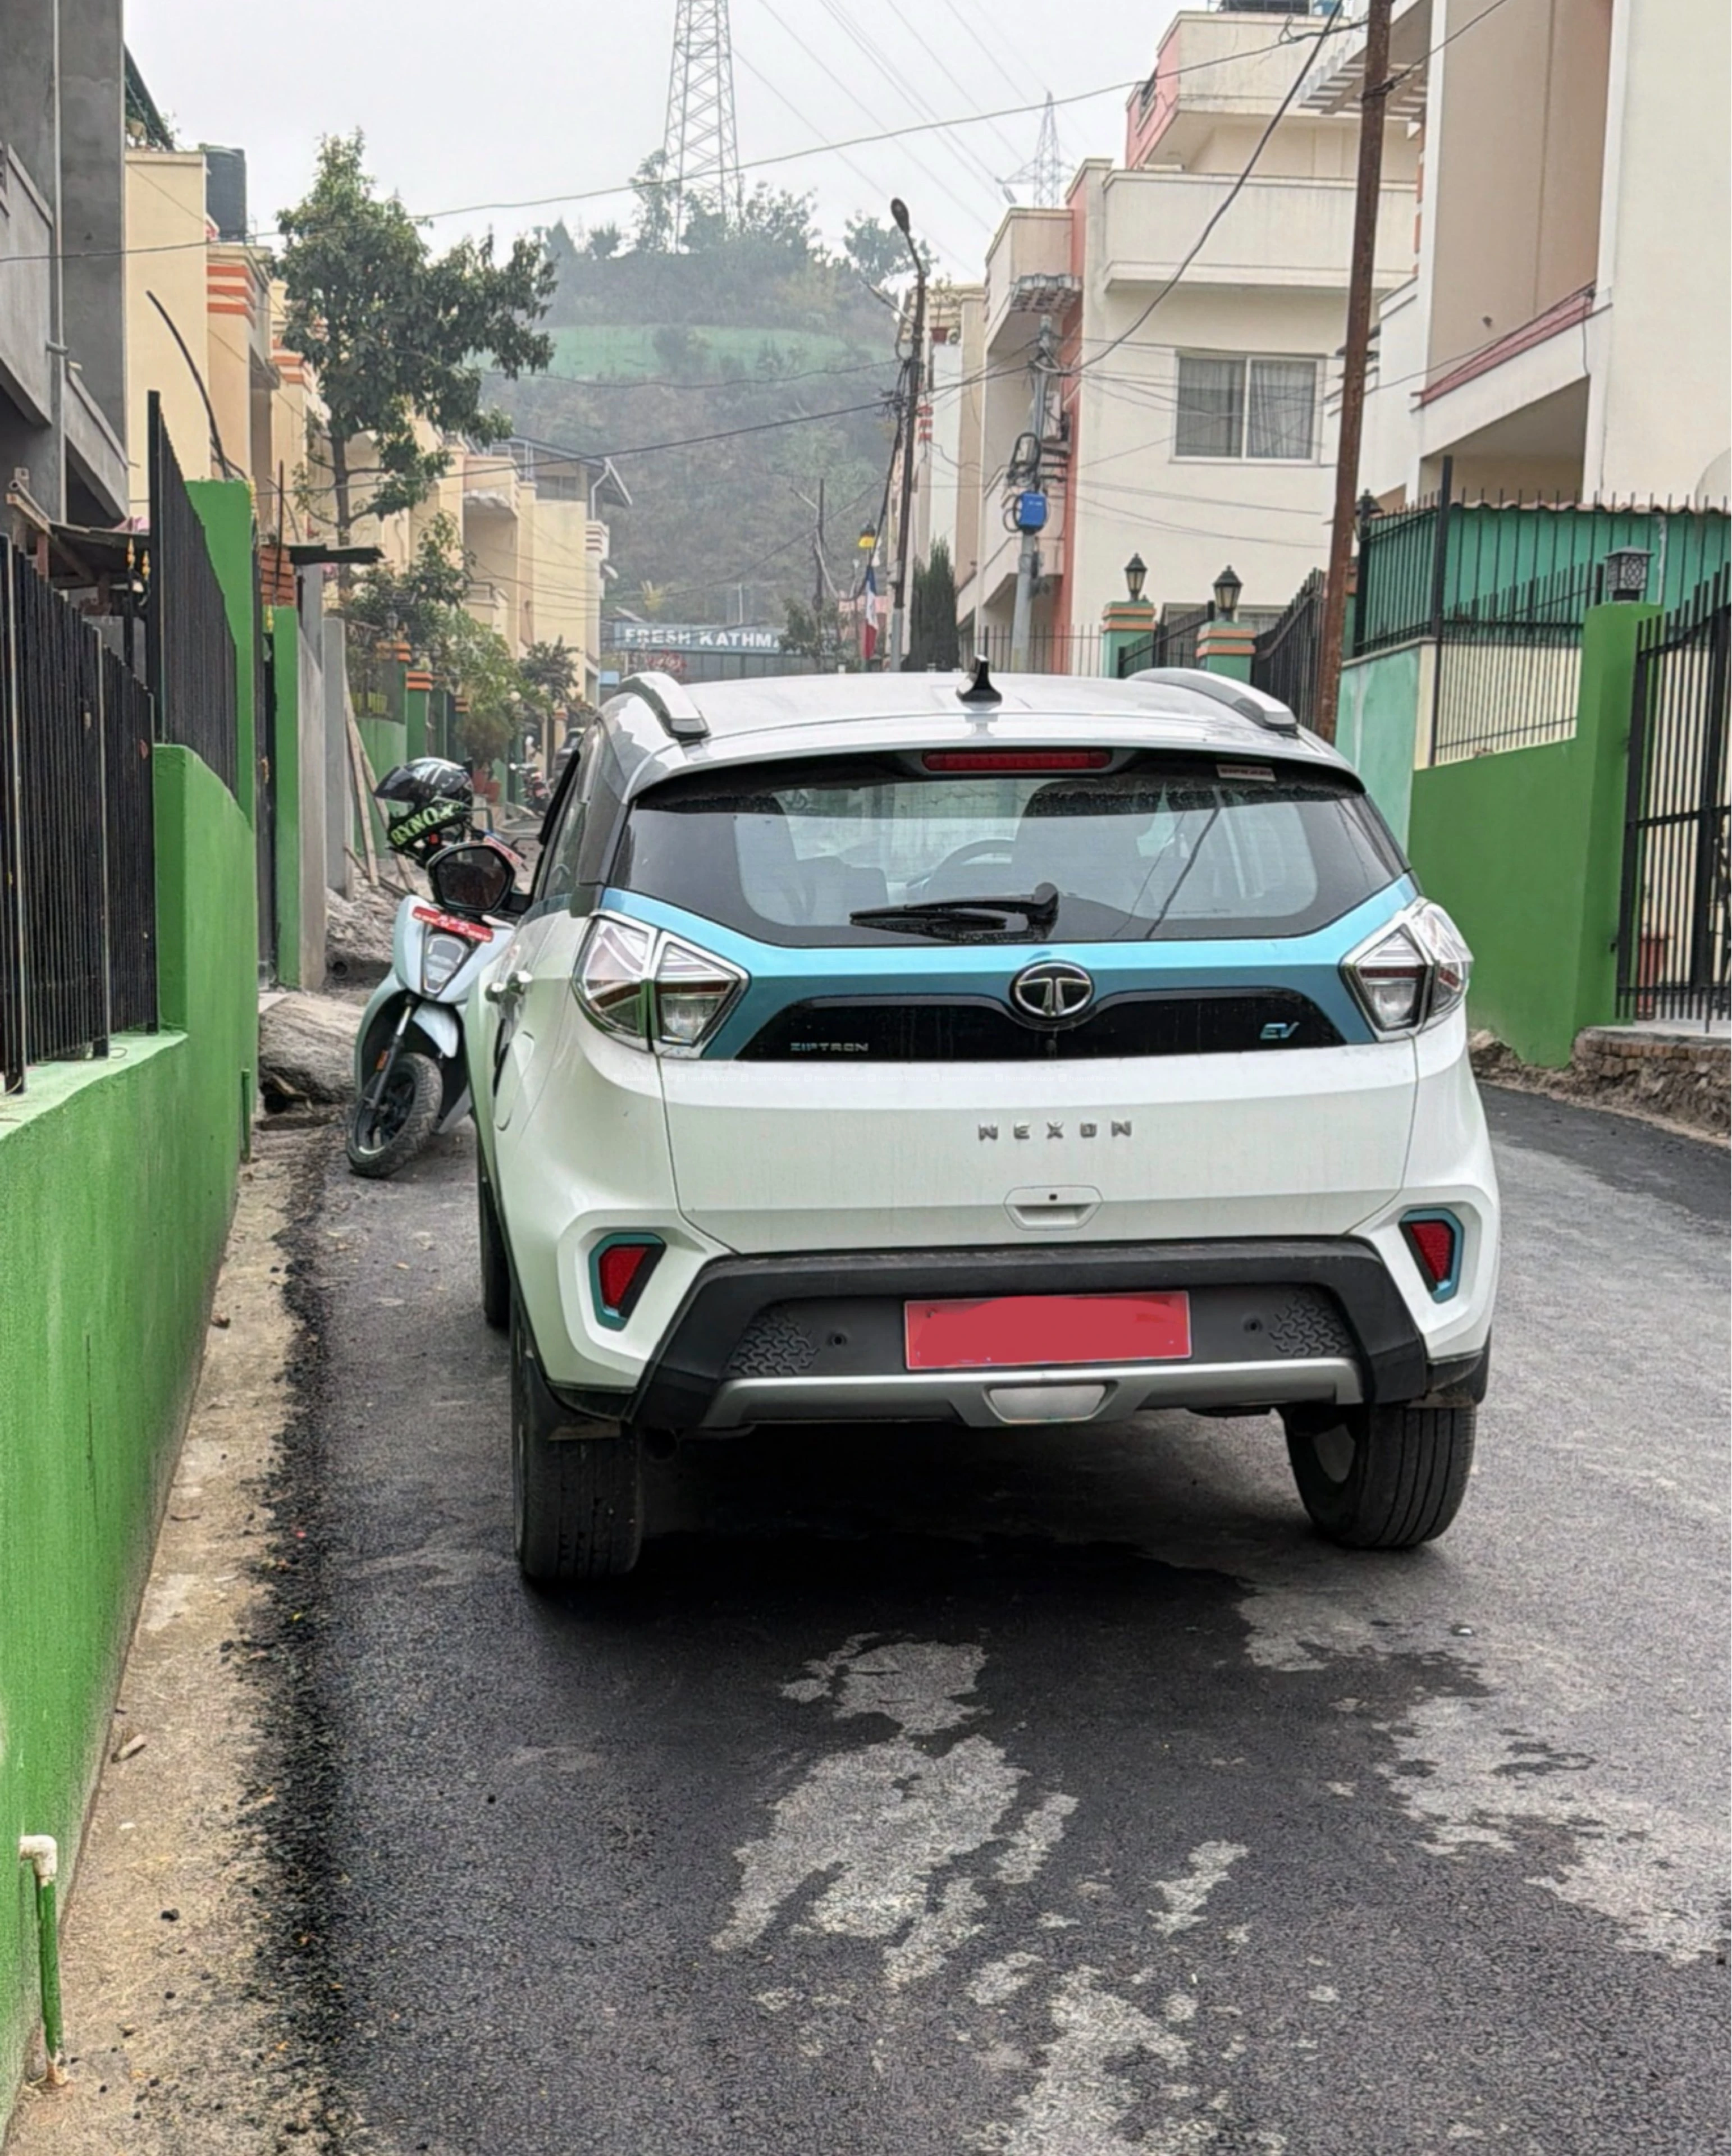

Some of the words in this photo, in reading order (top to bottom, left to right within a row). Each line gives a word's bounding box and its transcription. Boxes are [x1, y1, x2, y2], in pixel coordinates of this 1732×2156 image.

[624, 628, 691, 645] FRESH
[1260, 1022, 1300, 1039] EV
[790, 1043, 869, 1052] ZIPTRON
[978, 1121, 1132, 1141] NEXON
